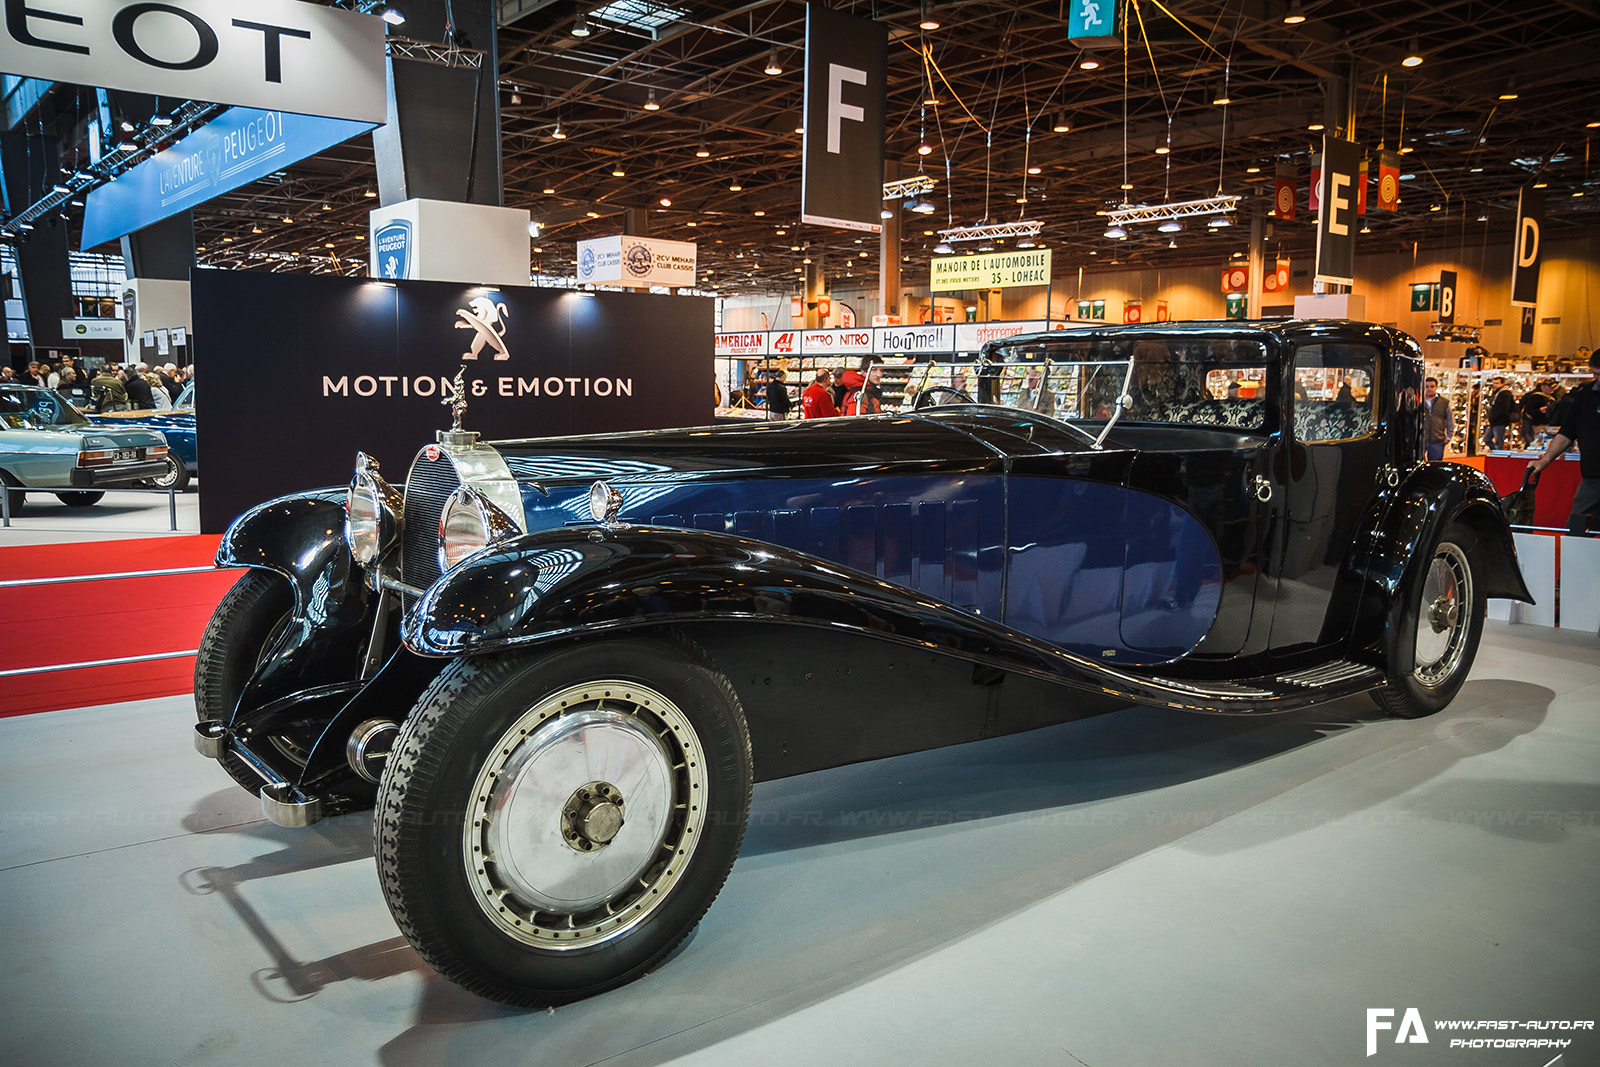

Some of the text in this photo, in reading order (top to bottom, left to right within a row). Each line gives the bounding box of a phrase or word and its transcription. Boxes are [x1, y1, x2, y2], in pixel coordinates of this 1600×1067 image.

[827, 63, 867, 154] F
[160, 112, 283, 195] L'AVENTURE PEUGEOT
[1329, 172, 1350, 236] E
[379, 233, 405, 245] L'AVENTURE
[379, 241, 405, 253] PEUGEOT
[1518, 216, 1540, 268] D
[656, 254, 695, 264] 2CV MEHARI
[657, 262, 694, 272] CLUB CASSIS
[936, 254, 1045, 274] MANOIR DE L'AUTOMOBILE
[991, 272, 1002, 284] 35
[1012, 270, 1045, 283] LOHEAC
[1441, 287, 1453, 317] B
[715, 334, 763, 348] AMERICAN
[805, 333, 869, 346] NITRO NITRO
[883, 328, 943, 350] Hommell
[322, 375, 632, 397] MOTION & EMOTION
